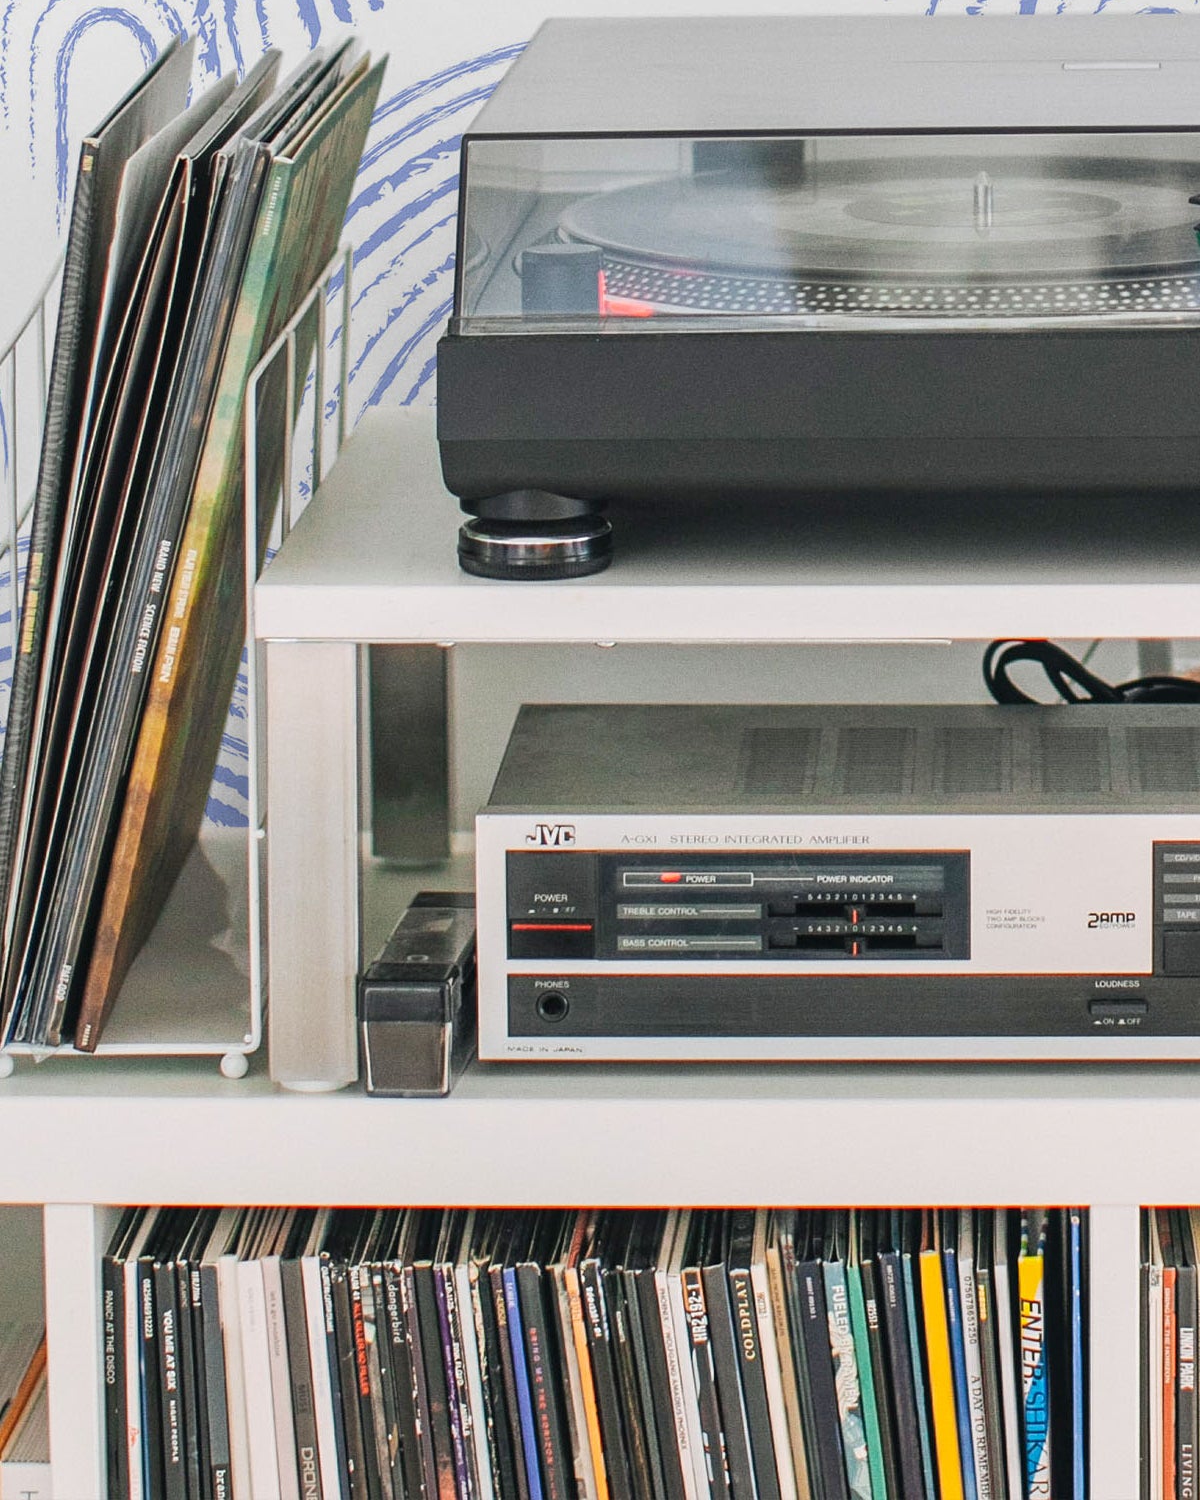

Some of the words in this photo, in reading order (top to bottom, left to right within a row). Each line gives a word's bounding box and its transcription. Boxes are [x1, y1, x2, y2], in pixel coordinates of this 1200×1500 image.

[157, 540, 171, 571] BRAND
[151, 571, 164, 593] NEW
[139, 603, 156, 638] SCIENCE
[132, 639, 148, 673] FICTION
[525, 824, 576, 846] JVC
[670, 835, 719, 844] STEREO
[725, 835, 802, 845] INTEGRATED
[809, 835, 870, 844] AMPLIFIER
[534, 894, 567, 902] POWER
[623, 939, 645, 947] BASS
[648, 939, 689, 947] CONTROL
[1095, 980, 1140, 988] LOUDNESS
[105, 1290, 114, 1319] PANIC!
[387, 1284, 402, 1343] dangerbird
[688, 1284, 708, 1344] HR2192-1
[831, 1285, 849, 1333] FUELED
[106, 1322, 114, 1333] AT
[163, 1310, 173, 1333] YOU
[659, 1288, 669, 1321] PHOENIX
[665, 1332, 678, 1376] WOLFGANG
[735, 1280, 756, 1361] COLDPLAY
[107, 1335, 115, 1352] THE
[164, 1335, 174, 1352] ME
[354, 1320, 365, 1350] KILLER
[1180, 1327, 1194, 1360] LINKIN
[106, 1355, 116, 1384] DISCO
[165, 1355, 175, 1368] AT
[357, 1351, 366, 1364] NO
[166, 1371, 176, 1390] SIX
[359, 1365, 369, 1395] FILLER
[970, 1375, 981, 1384] A
[1180, 1363, 1194, 1390] PARK
[971, 1387, 985, 1414] DAY
[975, 1416, 986, 1433] TO
[171, 1428, 179, 1463] PEOPLE
[1025, 1391, 1050, 1500] SHIKAR
[1182, 1443, 1193, 1498] LIVING
